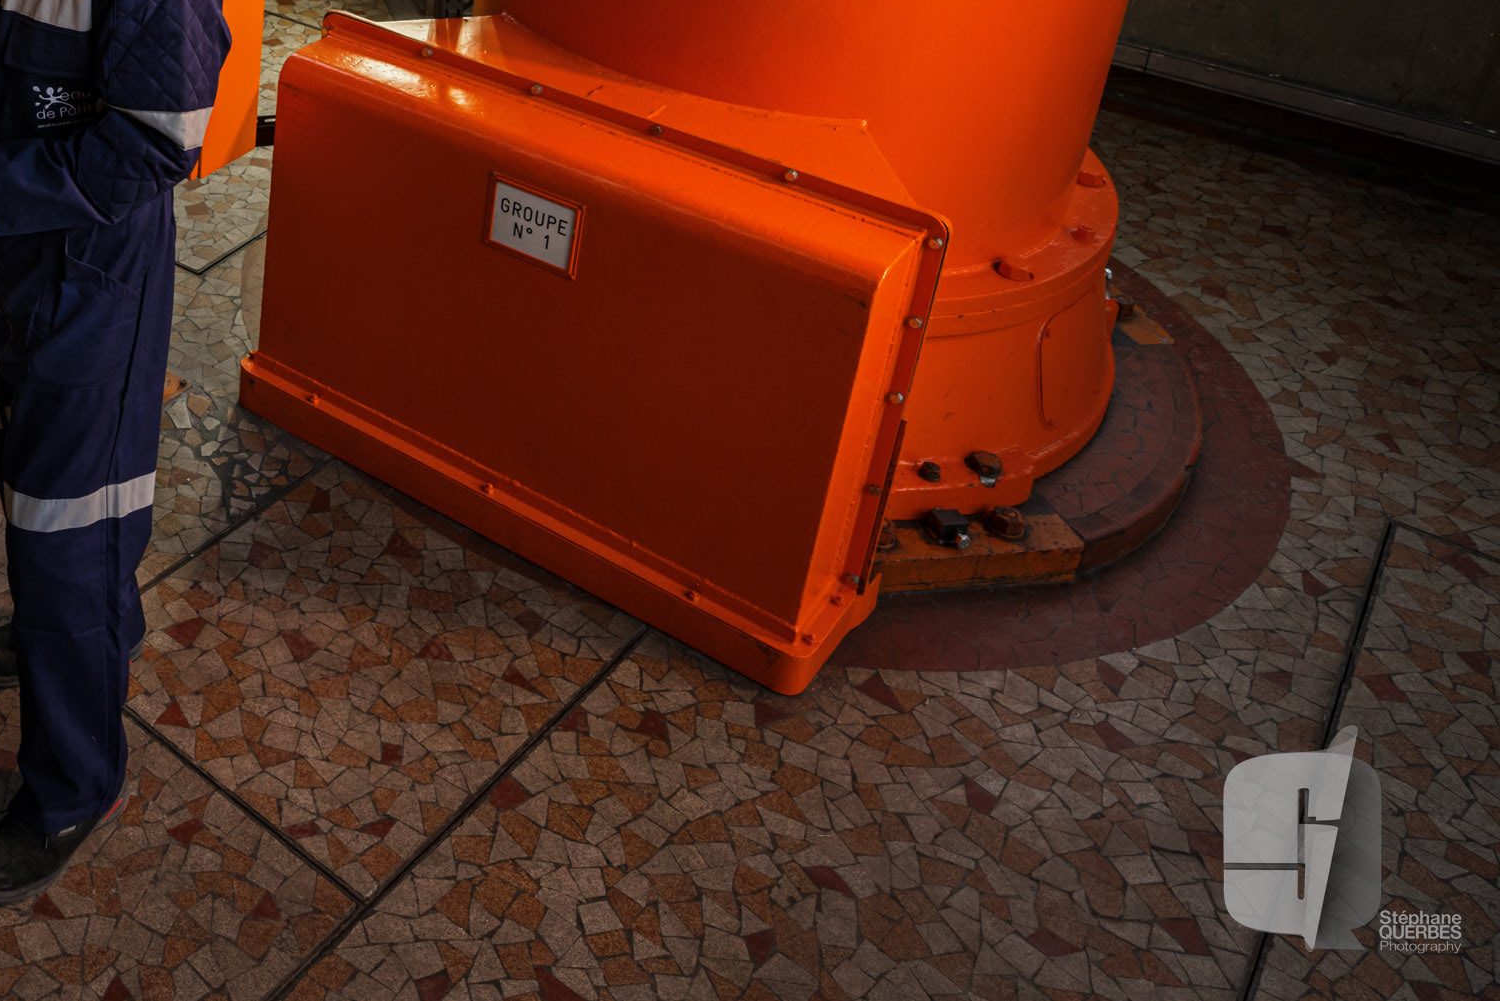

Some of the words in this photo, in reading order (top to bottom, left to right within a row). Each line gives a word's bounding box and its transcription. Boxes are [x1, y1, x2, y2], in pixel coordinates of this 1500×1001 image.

[60, 90, 91, 101] eau
[36, 108, 56, 120] de
[60, 101, 93, 118] Paris
[500, 197, 568, 237] GROUPE
[513, 221, 533, 239] N°
[543, 234, 550, 250] 1
